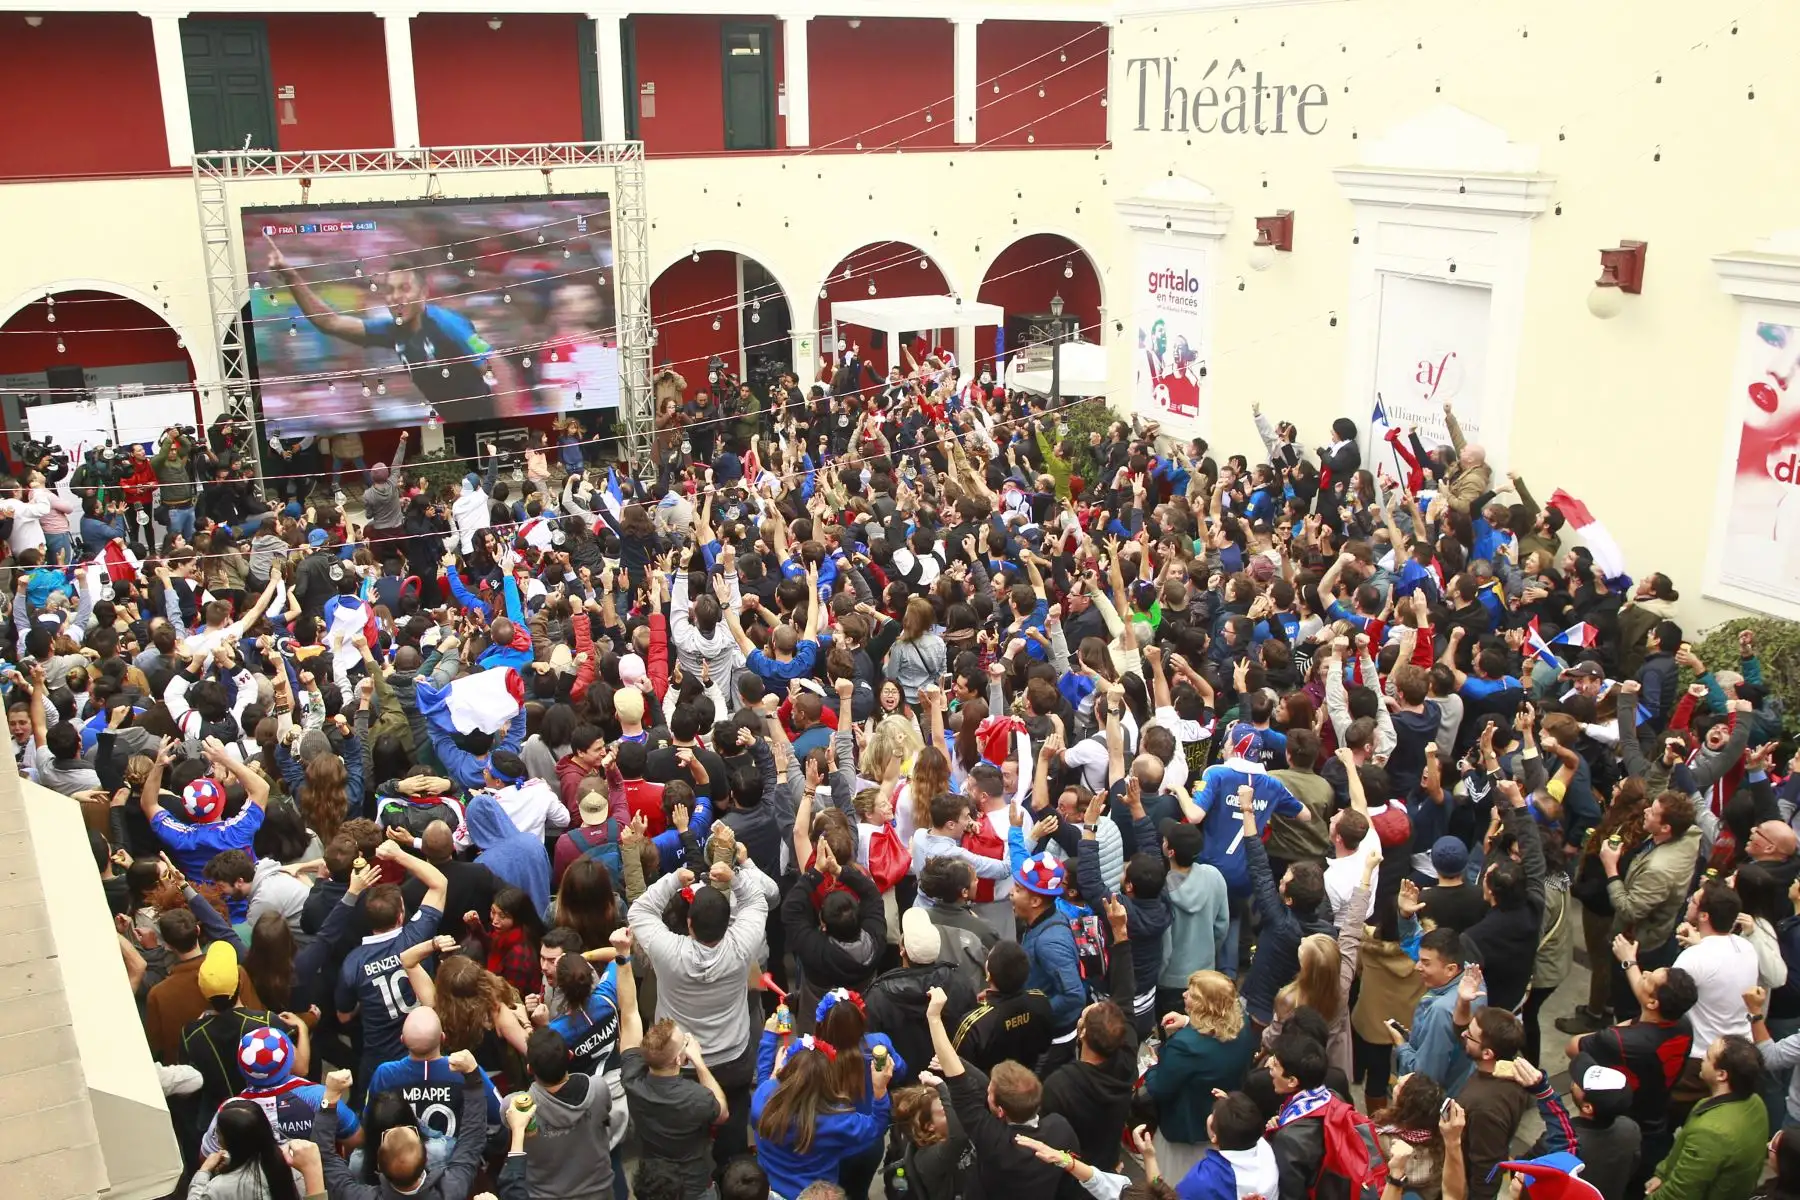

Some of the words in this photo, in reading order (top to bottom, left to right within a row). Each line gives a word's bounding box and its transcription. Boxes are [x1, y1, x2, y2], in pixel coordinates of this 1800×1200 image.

[1127, 57, 1329, 136] Théâtre
[278, 226, 294, 235] FRA
[323, 224, 338, 232] CRO
[1148, 268, 1199, 294] grítalo
[1156, 293, 1167, 303] en
[1415, 352, 1457, 401] af
[1225, 811, 1256, 855] 7
[371, 969, 422, 1020] 10
[1005, 1012, 1031, 1032] PERU
[402, 1086, 451, 1102] MBAPPE
